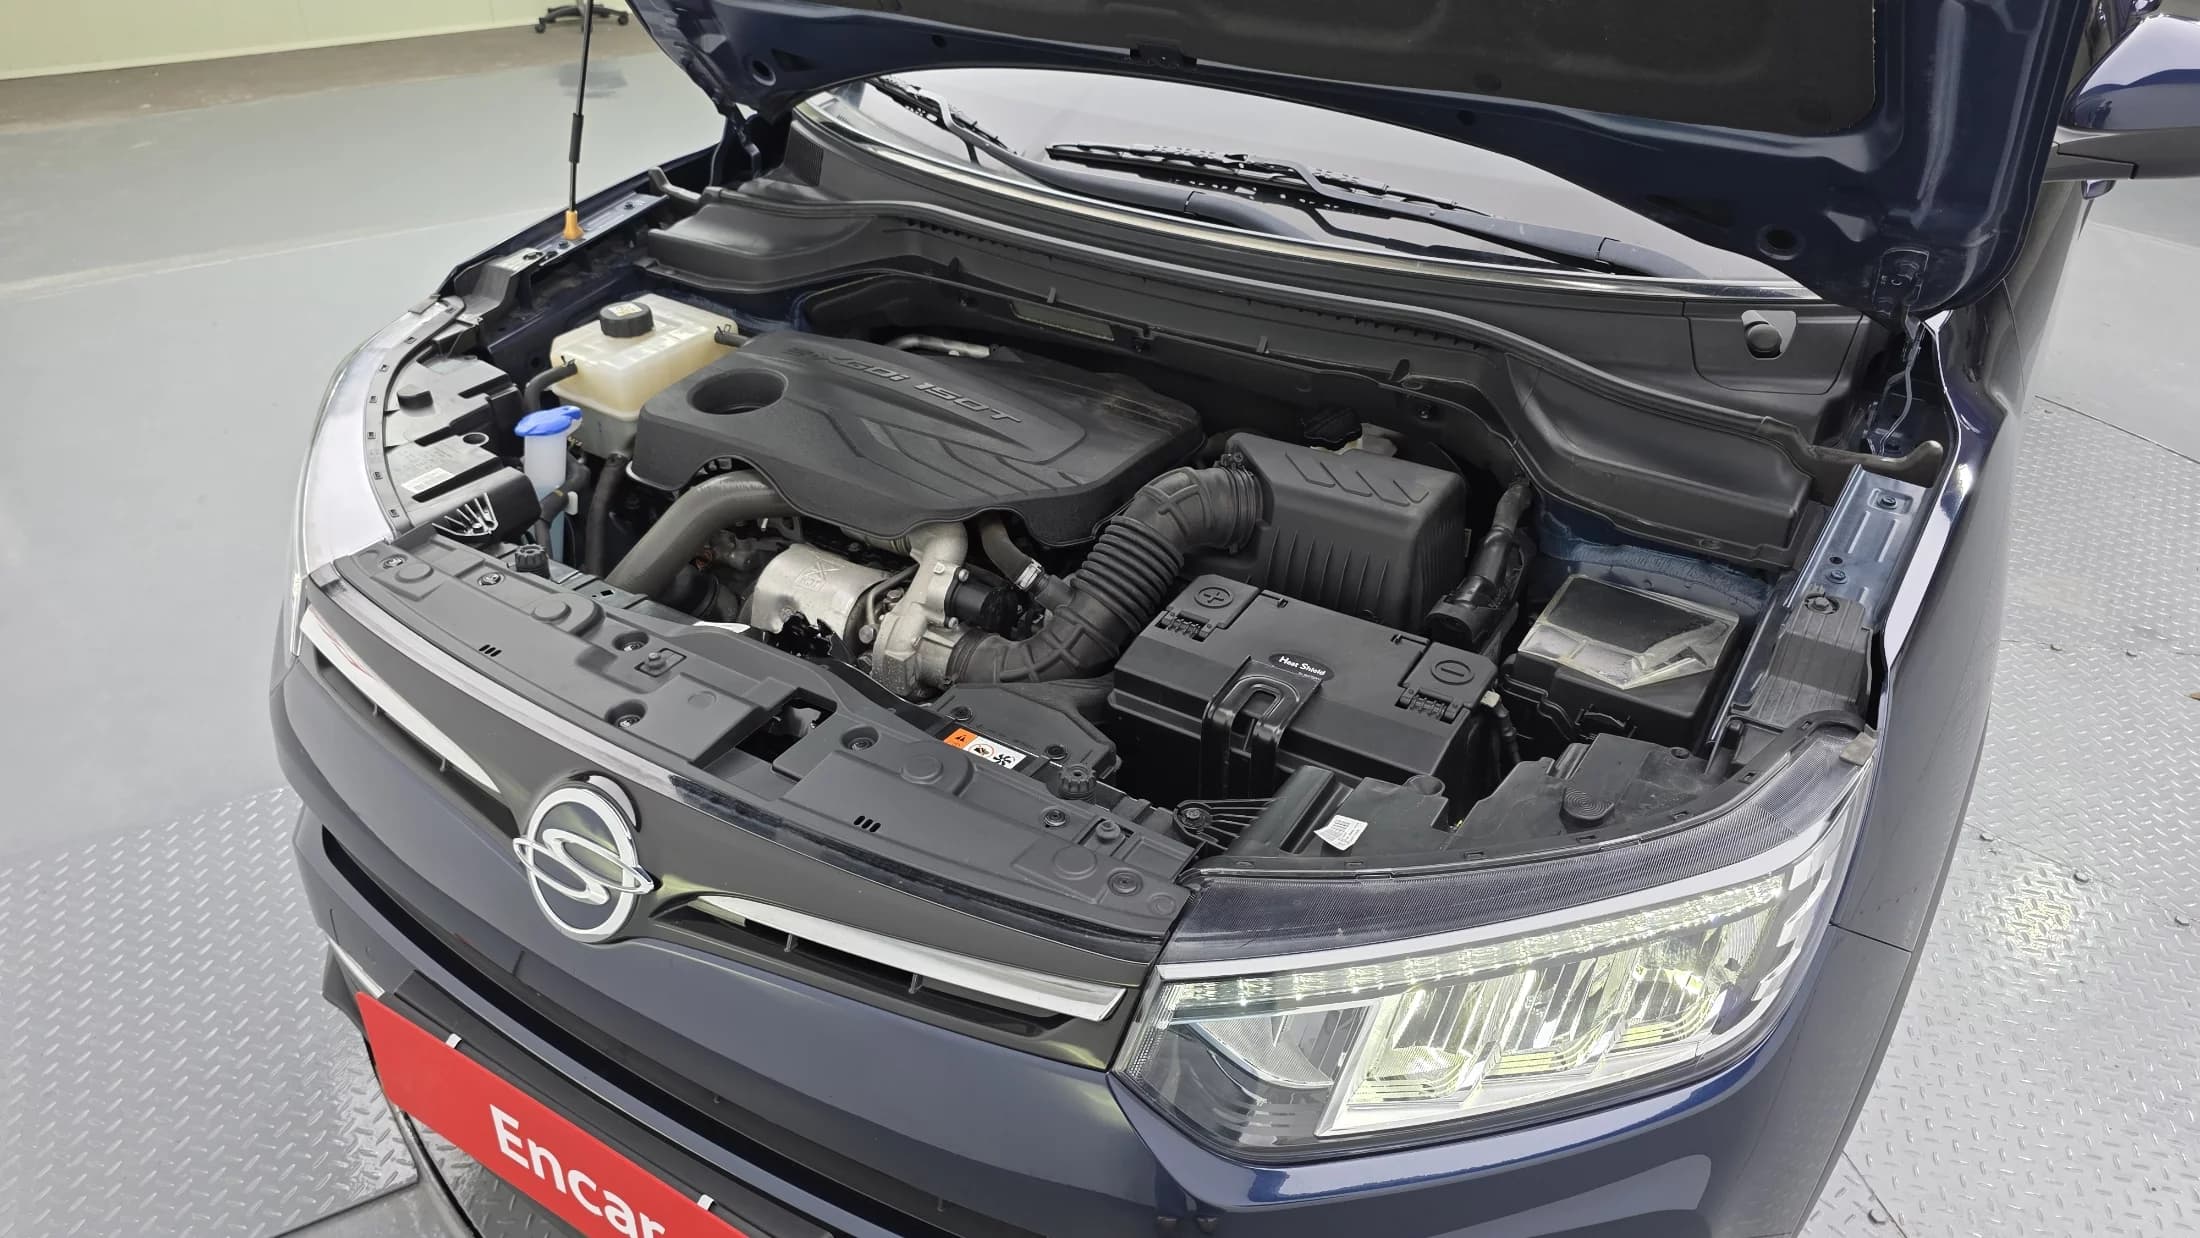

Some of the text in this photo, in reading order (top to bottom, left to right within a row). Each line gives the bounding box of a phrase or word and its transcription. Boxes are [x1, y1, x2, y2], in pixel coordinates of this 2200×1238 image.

[915, 382, 1022, 423] 150T
[1278, 655, 1327, 676] Heat Shield
[489, 1103, 666, 1238] Encar
